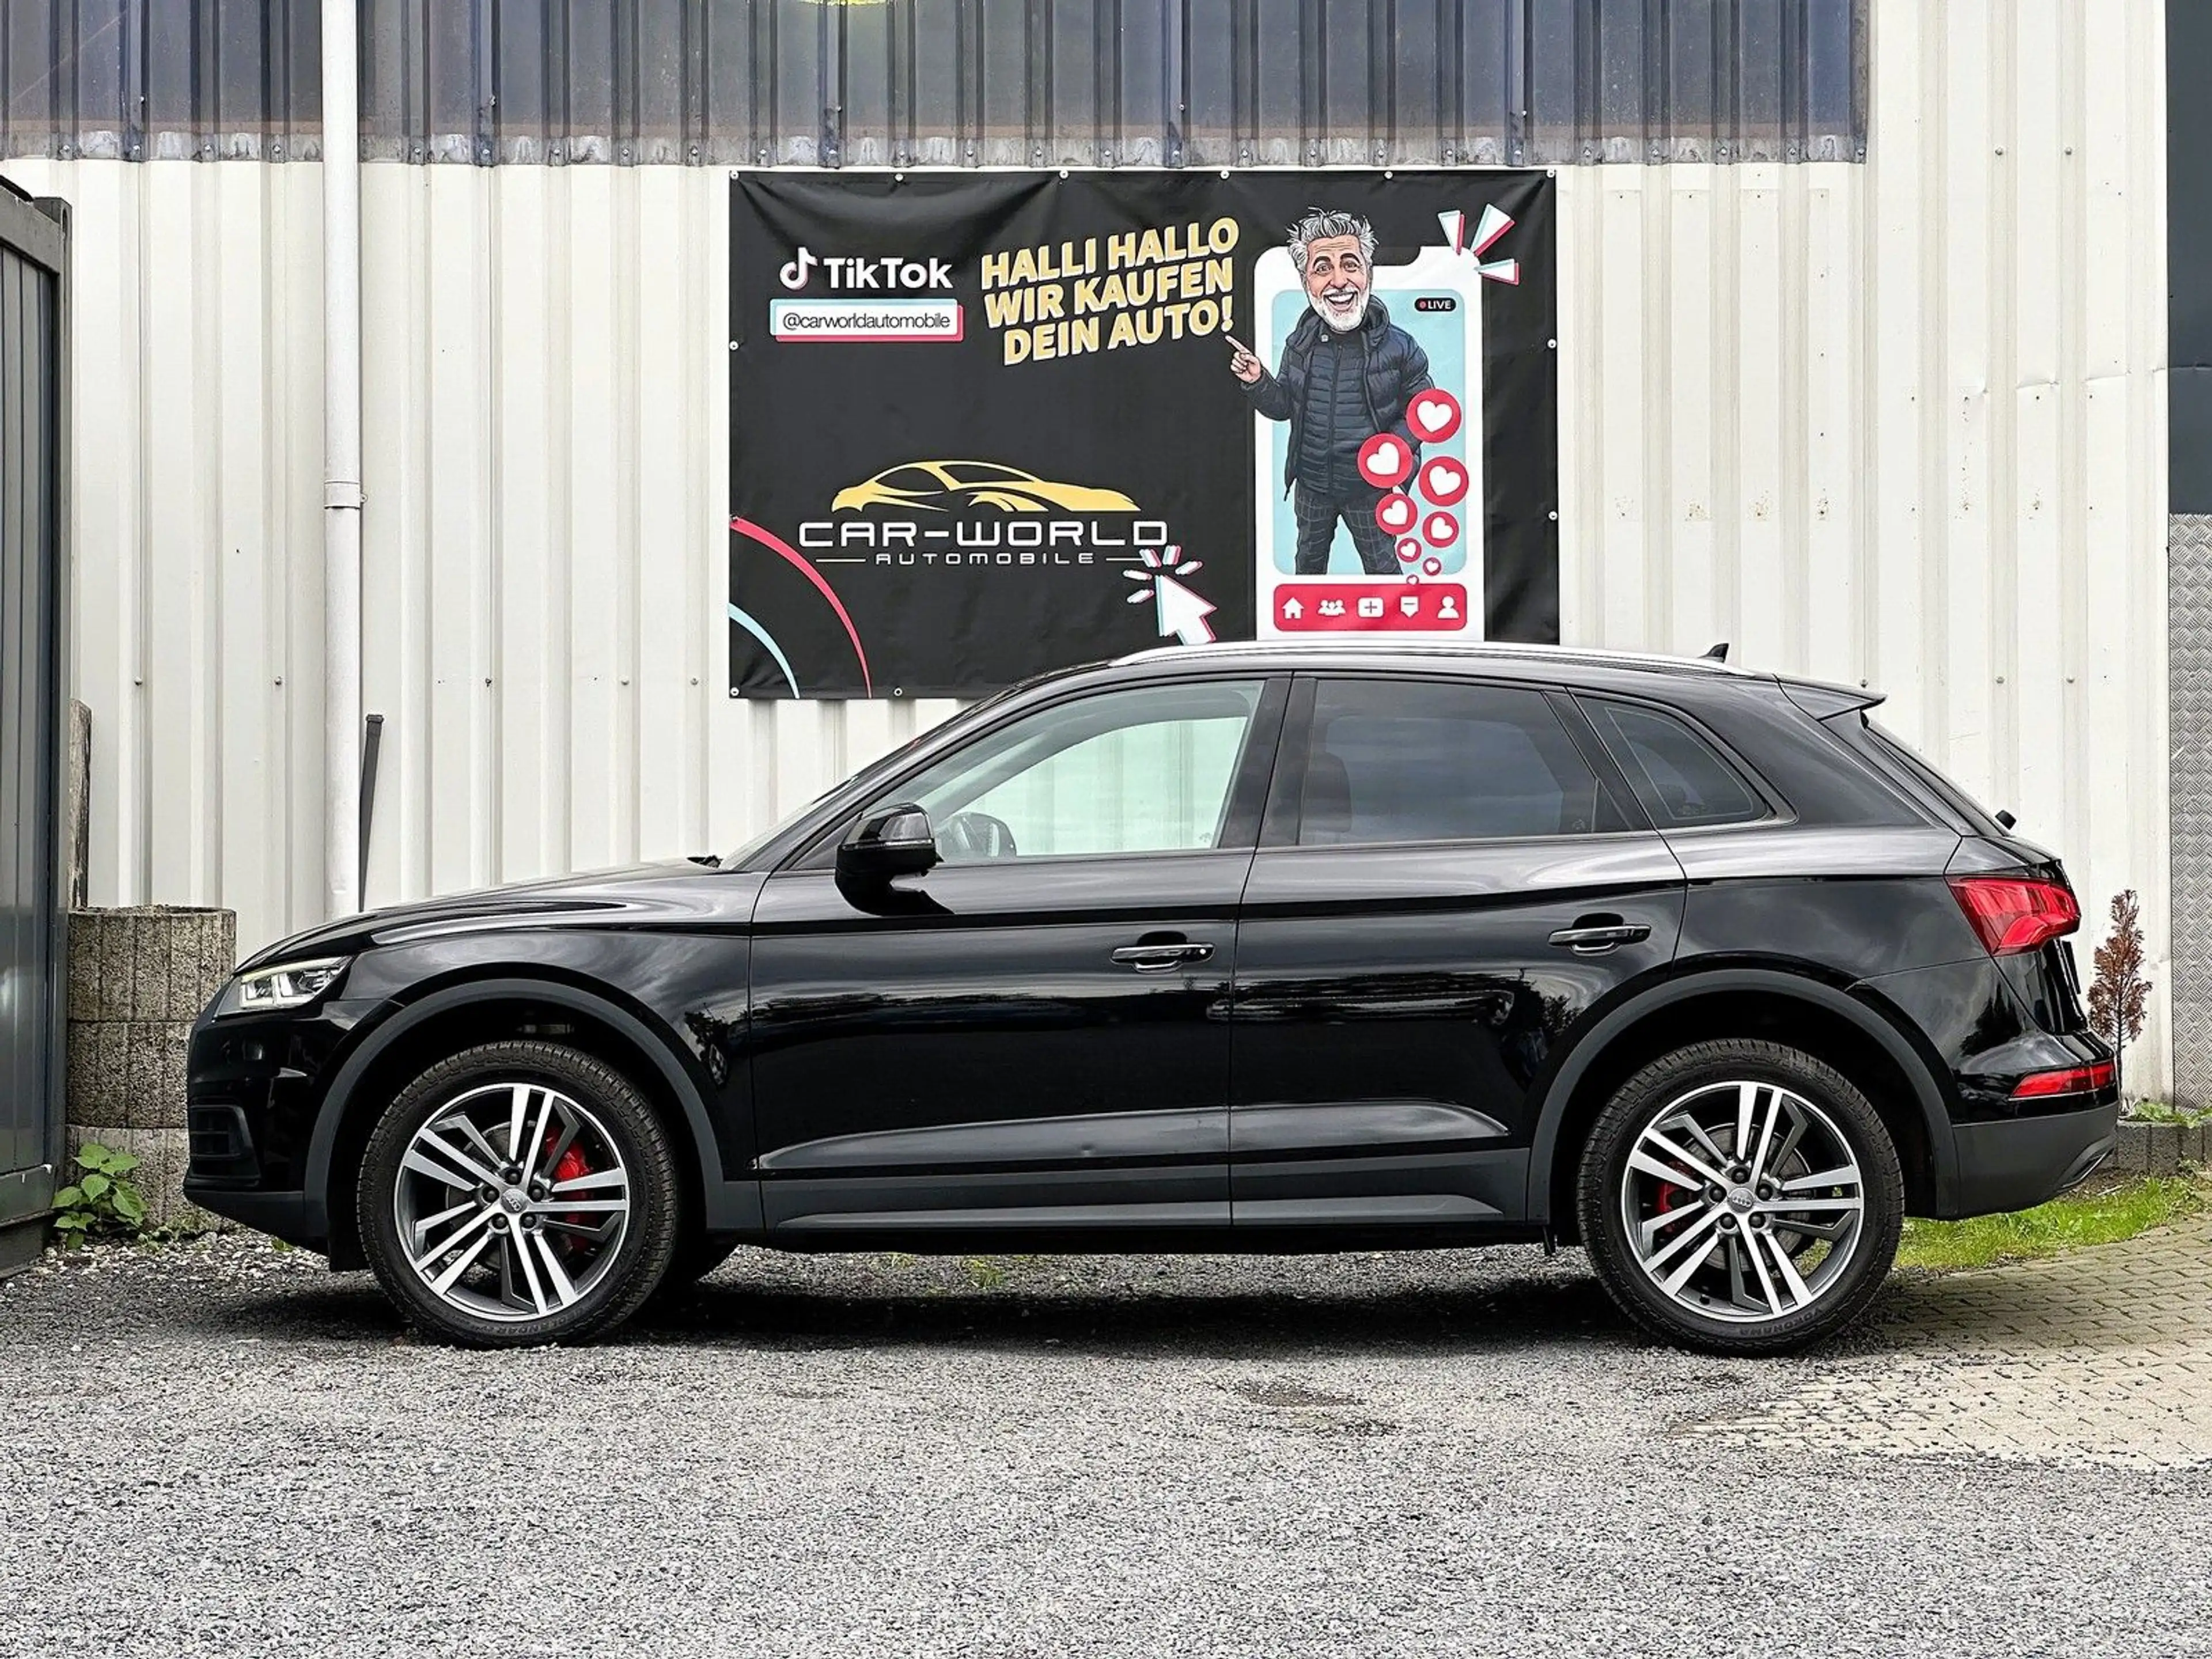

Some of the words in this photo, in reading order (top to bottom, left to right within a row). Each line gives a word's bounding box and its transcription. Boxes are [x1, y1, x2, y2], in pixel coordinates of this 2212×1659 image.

[981, 237, 1097, 290] HALLI
[1107, 217, 1240, 271] HALLO
[823, 257, 953, 289] TikTok
[984, 284, 1064, 328] WIR
[1074, 257, 1233, 315] KAUFEN
[1427, 300, 1451, 309] LIVE
[782, 312, 950, 331] @carworldautomobile
[1003, 316, 1099, 366] DEIN
[1107, 295, 1234, 350] AUTO!
[798, 521, 1168, 547] CAR-WORLD
[875, 552, 1094, 565] AUTOMOBILE
